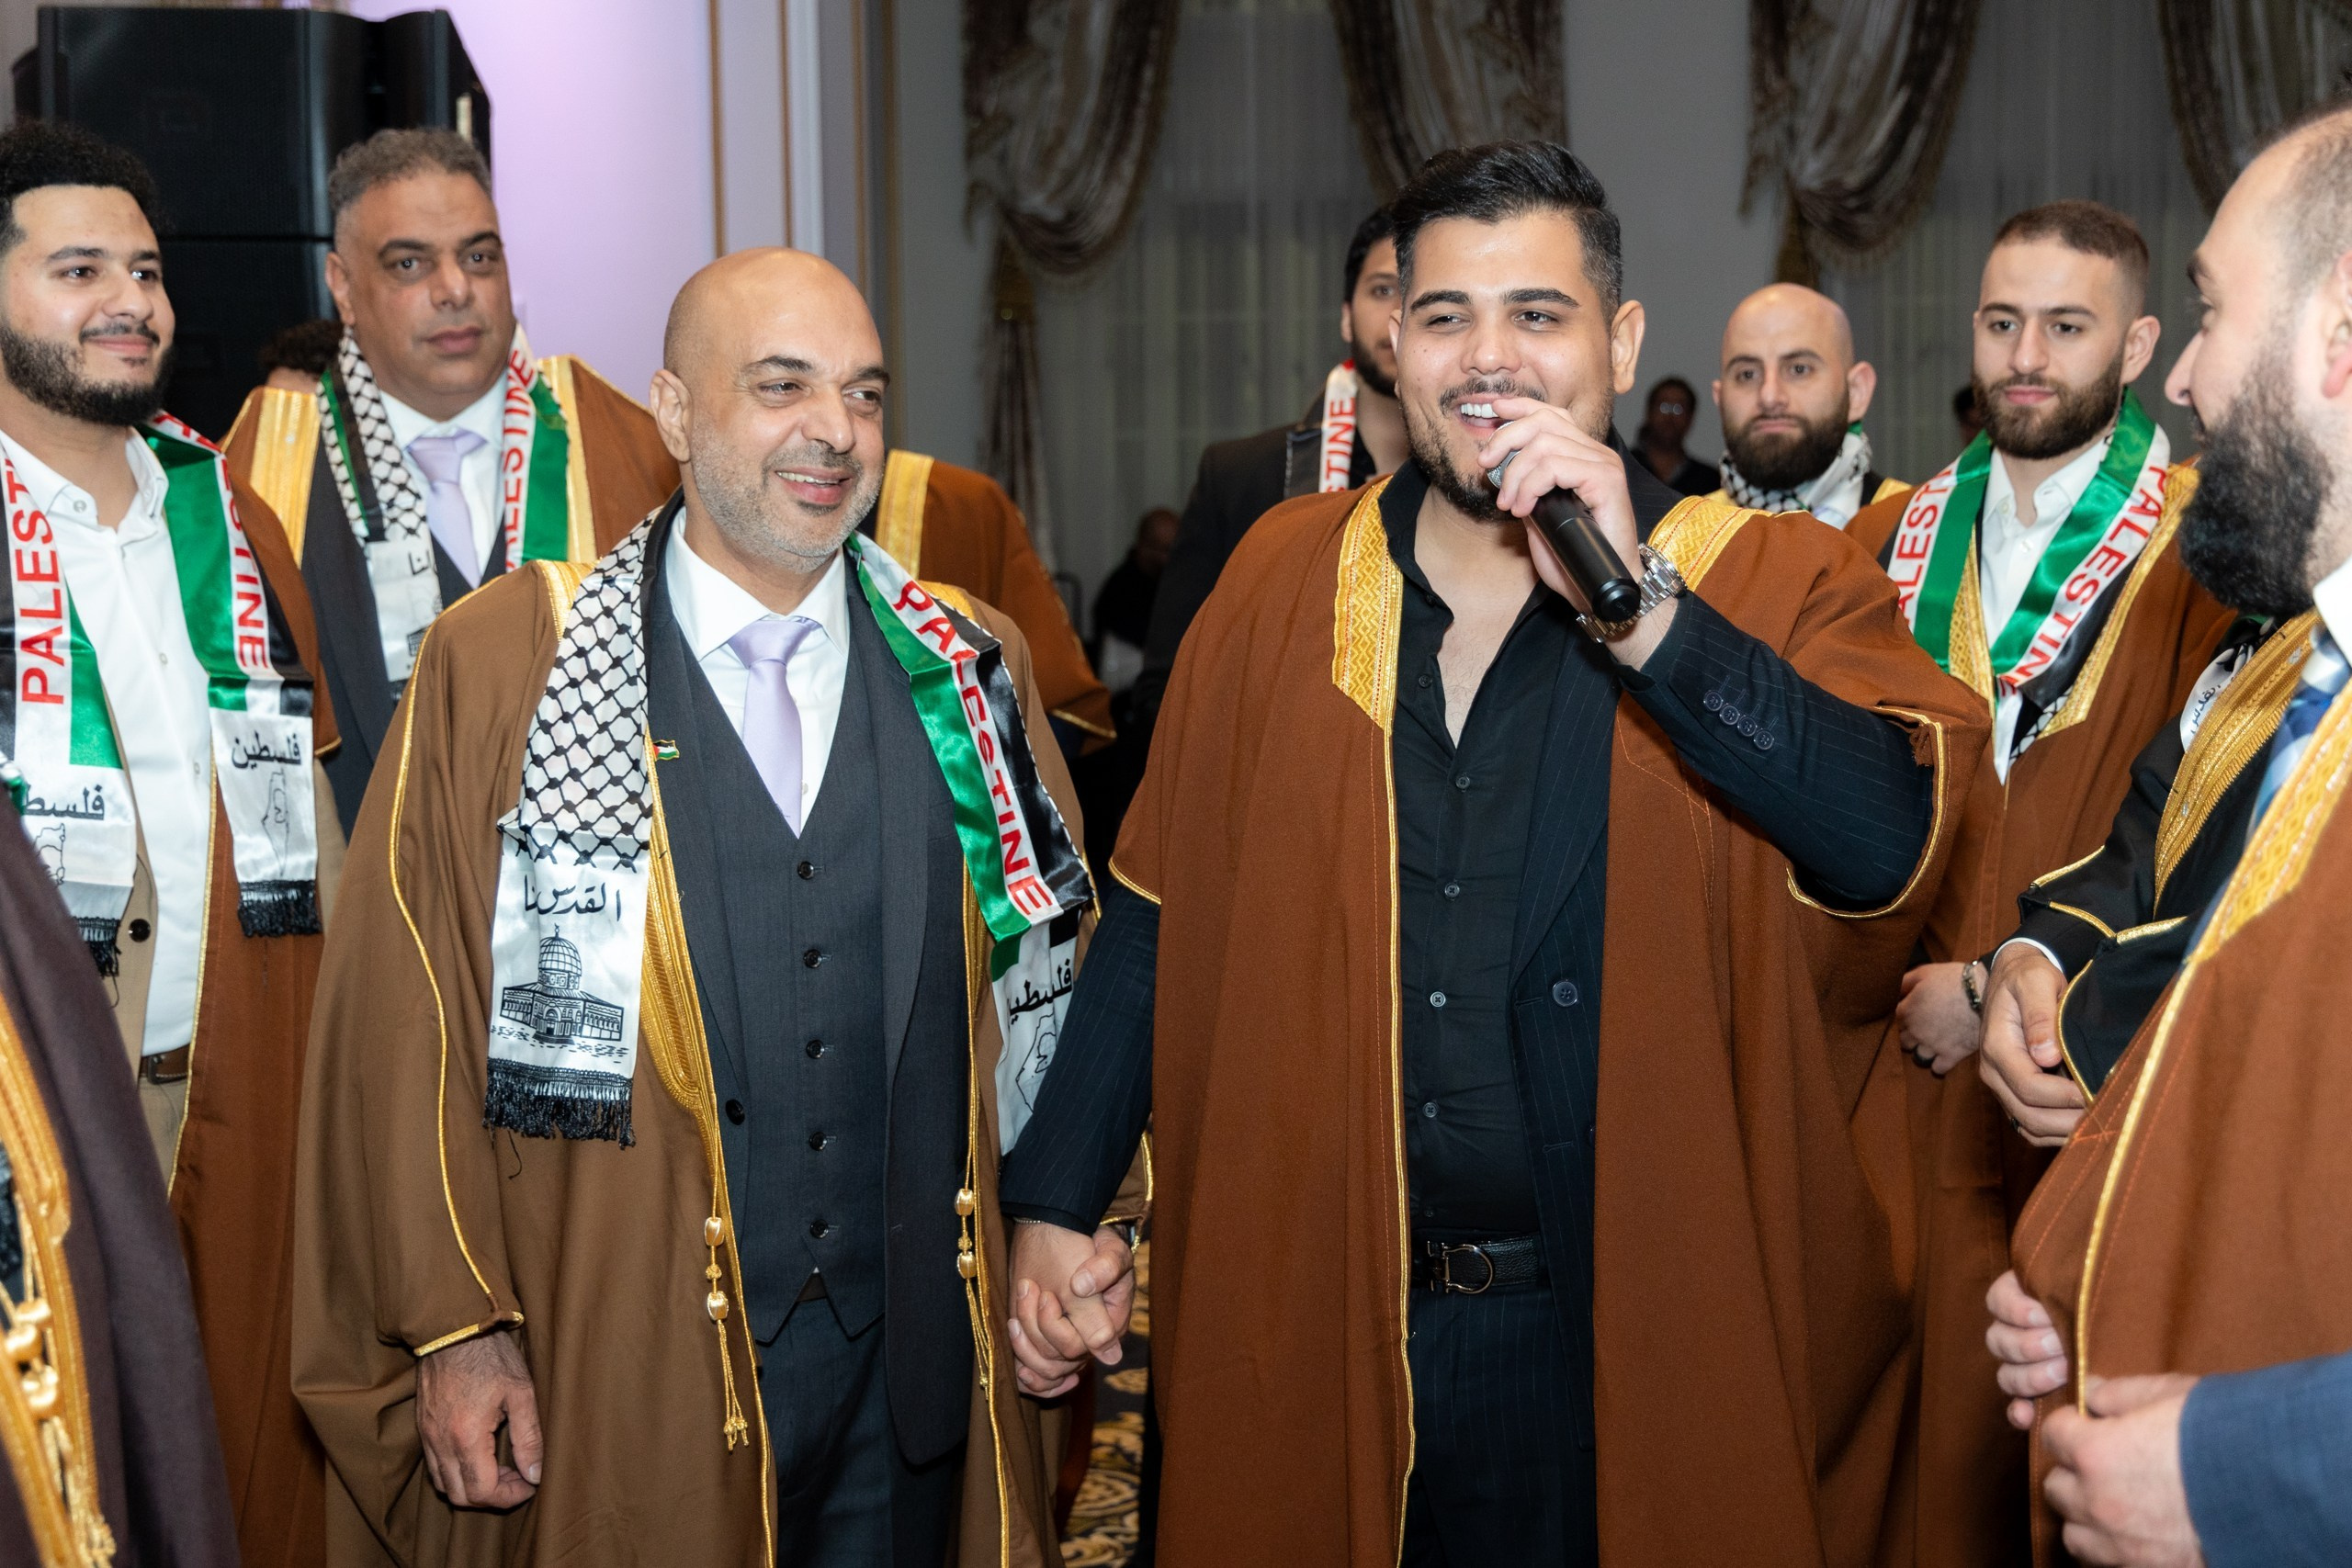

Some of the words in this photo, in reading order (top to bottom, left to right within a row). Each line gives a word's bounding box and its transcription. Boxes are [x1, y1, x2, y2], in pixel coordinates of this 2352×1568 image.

[504, 350, 536, 570] LESTINE
[23, 784, 105, 820] فلسط
[1007, 958, 1073, 1027] فلسطي
